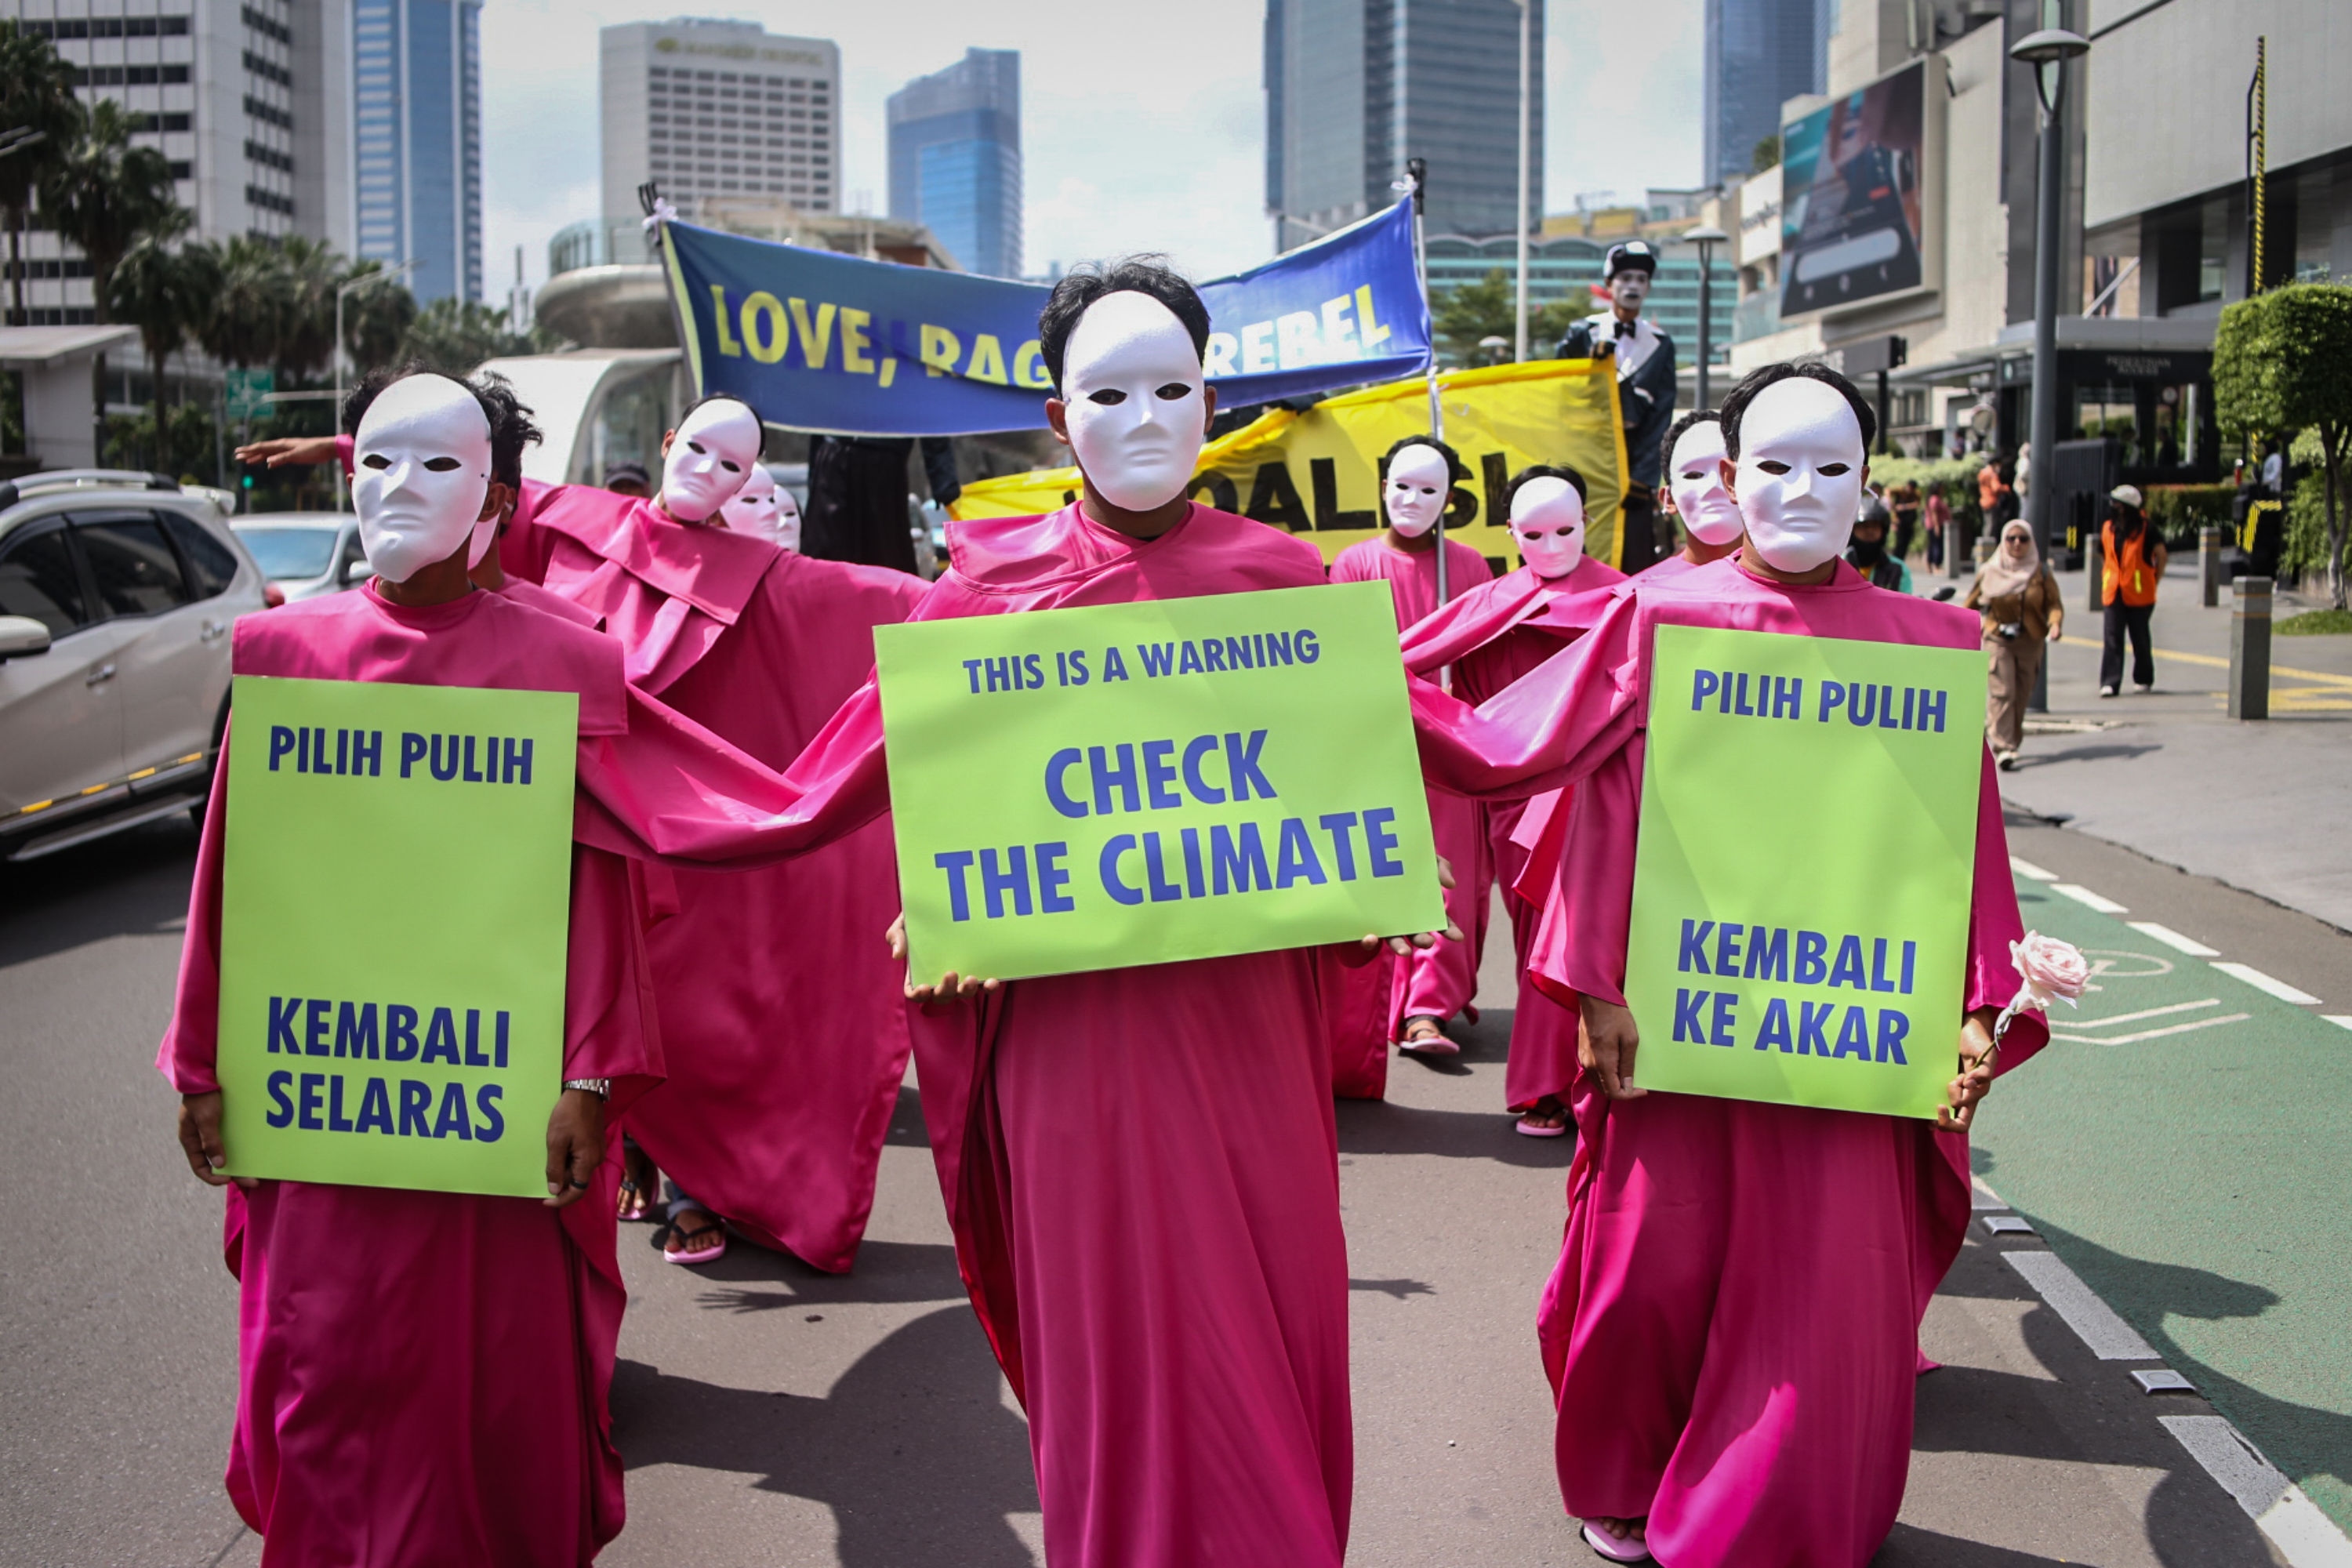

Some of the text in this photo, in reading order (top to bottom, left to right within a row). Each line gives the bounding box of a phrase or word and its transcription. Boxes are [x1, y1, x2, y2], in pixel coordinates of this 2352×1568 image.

[710, 284, 1391, 390] LOVE, RAG REBEL
[962, 629, 1320, 694] THIS IS A WARNING
[1691, 669, 1947, 733] PILIH PULIH
[269, 725, 534, 786] PILIH PULIH
[1044, 729, 1278, 819] CHECK
[935, 807, 1404, 922] THE CLIMATE
[1678, 918, 1917, 995] KEMBALI
[267, 996, 510, 1069] KEMBALI
[1672, 988, 1910, 1065] KE AKAR
[267, 1069, 505, 1143] SELARAS
